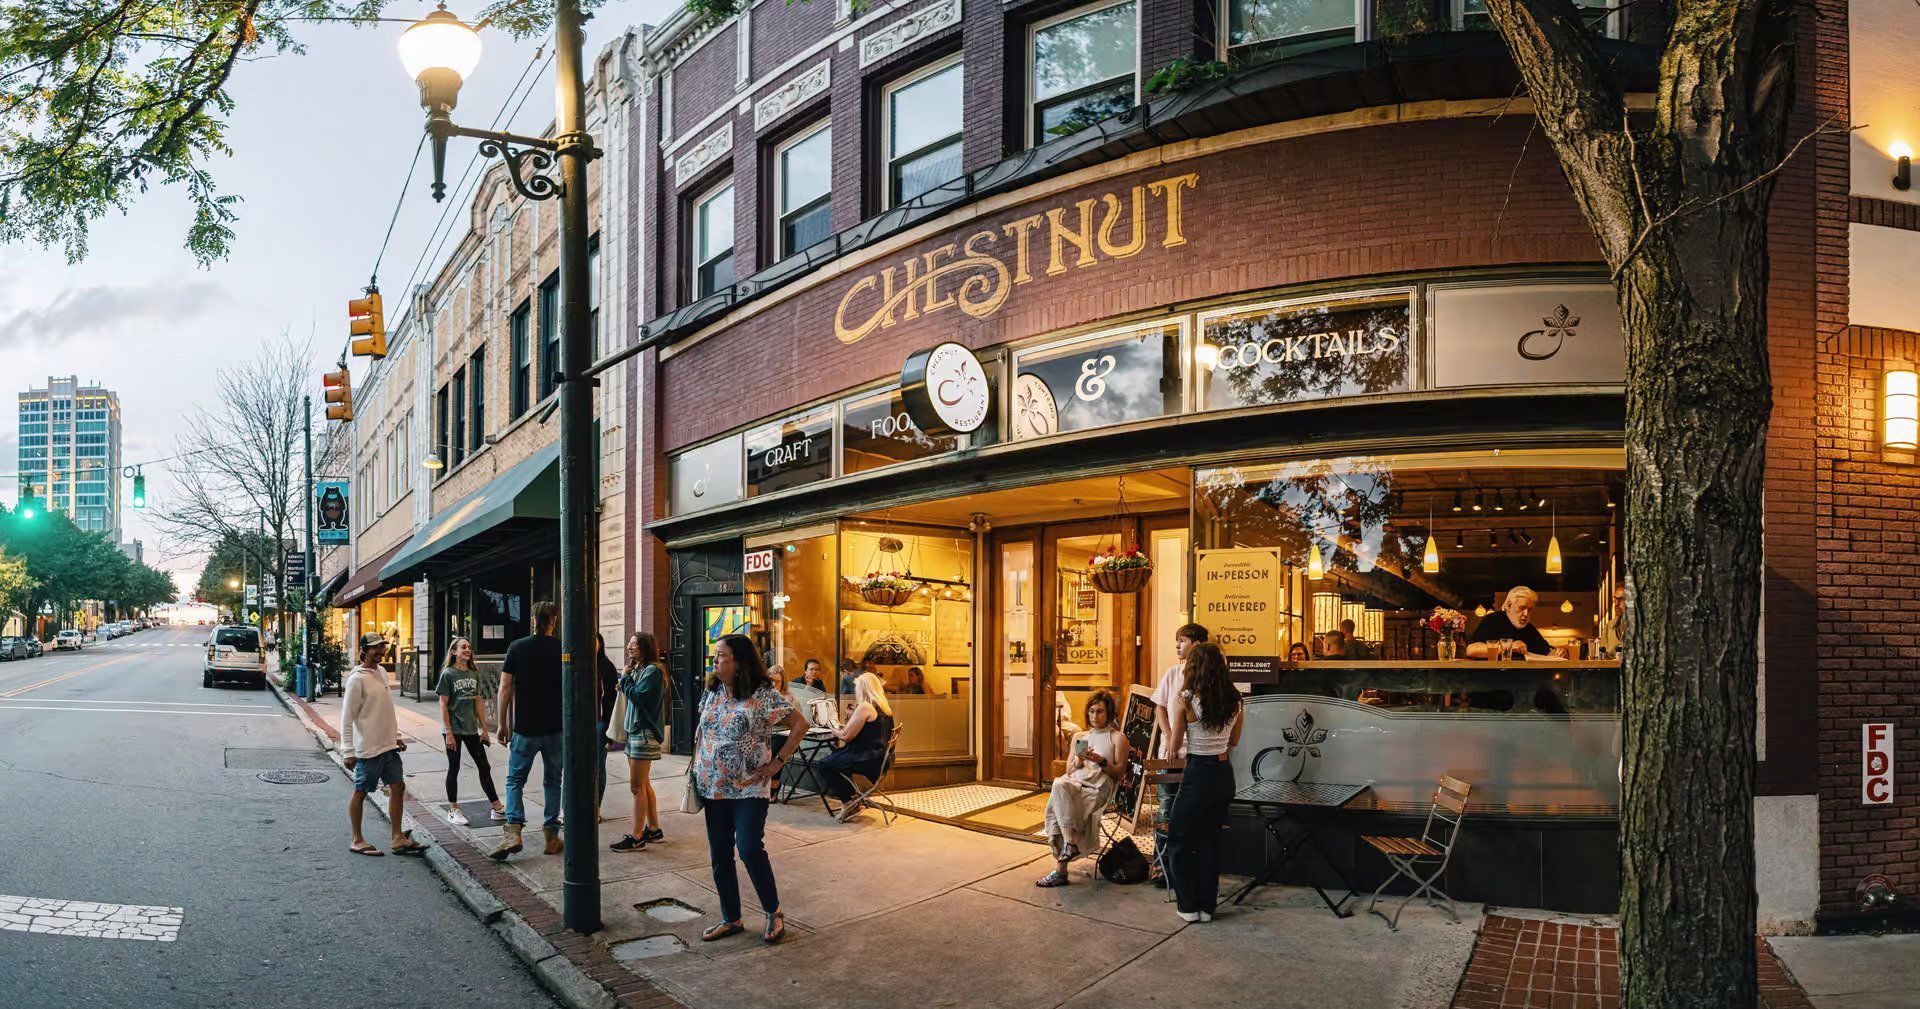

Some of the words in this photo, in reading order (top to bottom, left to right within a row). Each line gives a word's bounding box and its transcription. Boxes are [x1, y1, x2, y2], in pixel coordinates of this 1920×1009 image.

[834, 173, 1199, 344] CHESTNUT
[1216, 326, 1399, 370] COCKTAILS
[930, 349, 958, 376] CHESTNUT
[1075, 355, 1116, 401] &
[954, 394, 985, 427] RESTAURANT
[765, 438, 812, 467] CRAFT
[746, 553, 771, 570] FDC
[1207, 569, 1269, 581] IN-PERSON
[1208, 602, 1267, 612] DELIVERED
[1216, 634, 1257, 645] TO-GO
[1070, 649, 1104, 659] OPEN
[1866, 724, 1889, 803] FDC
